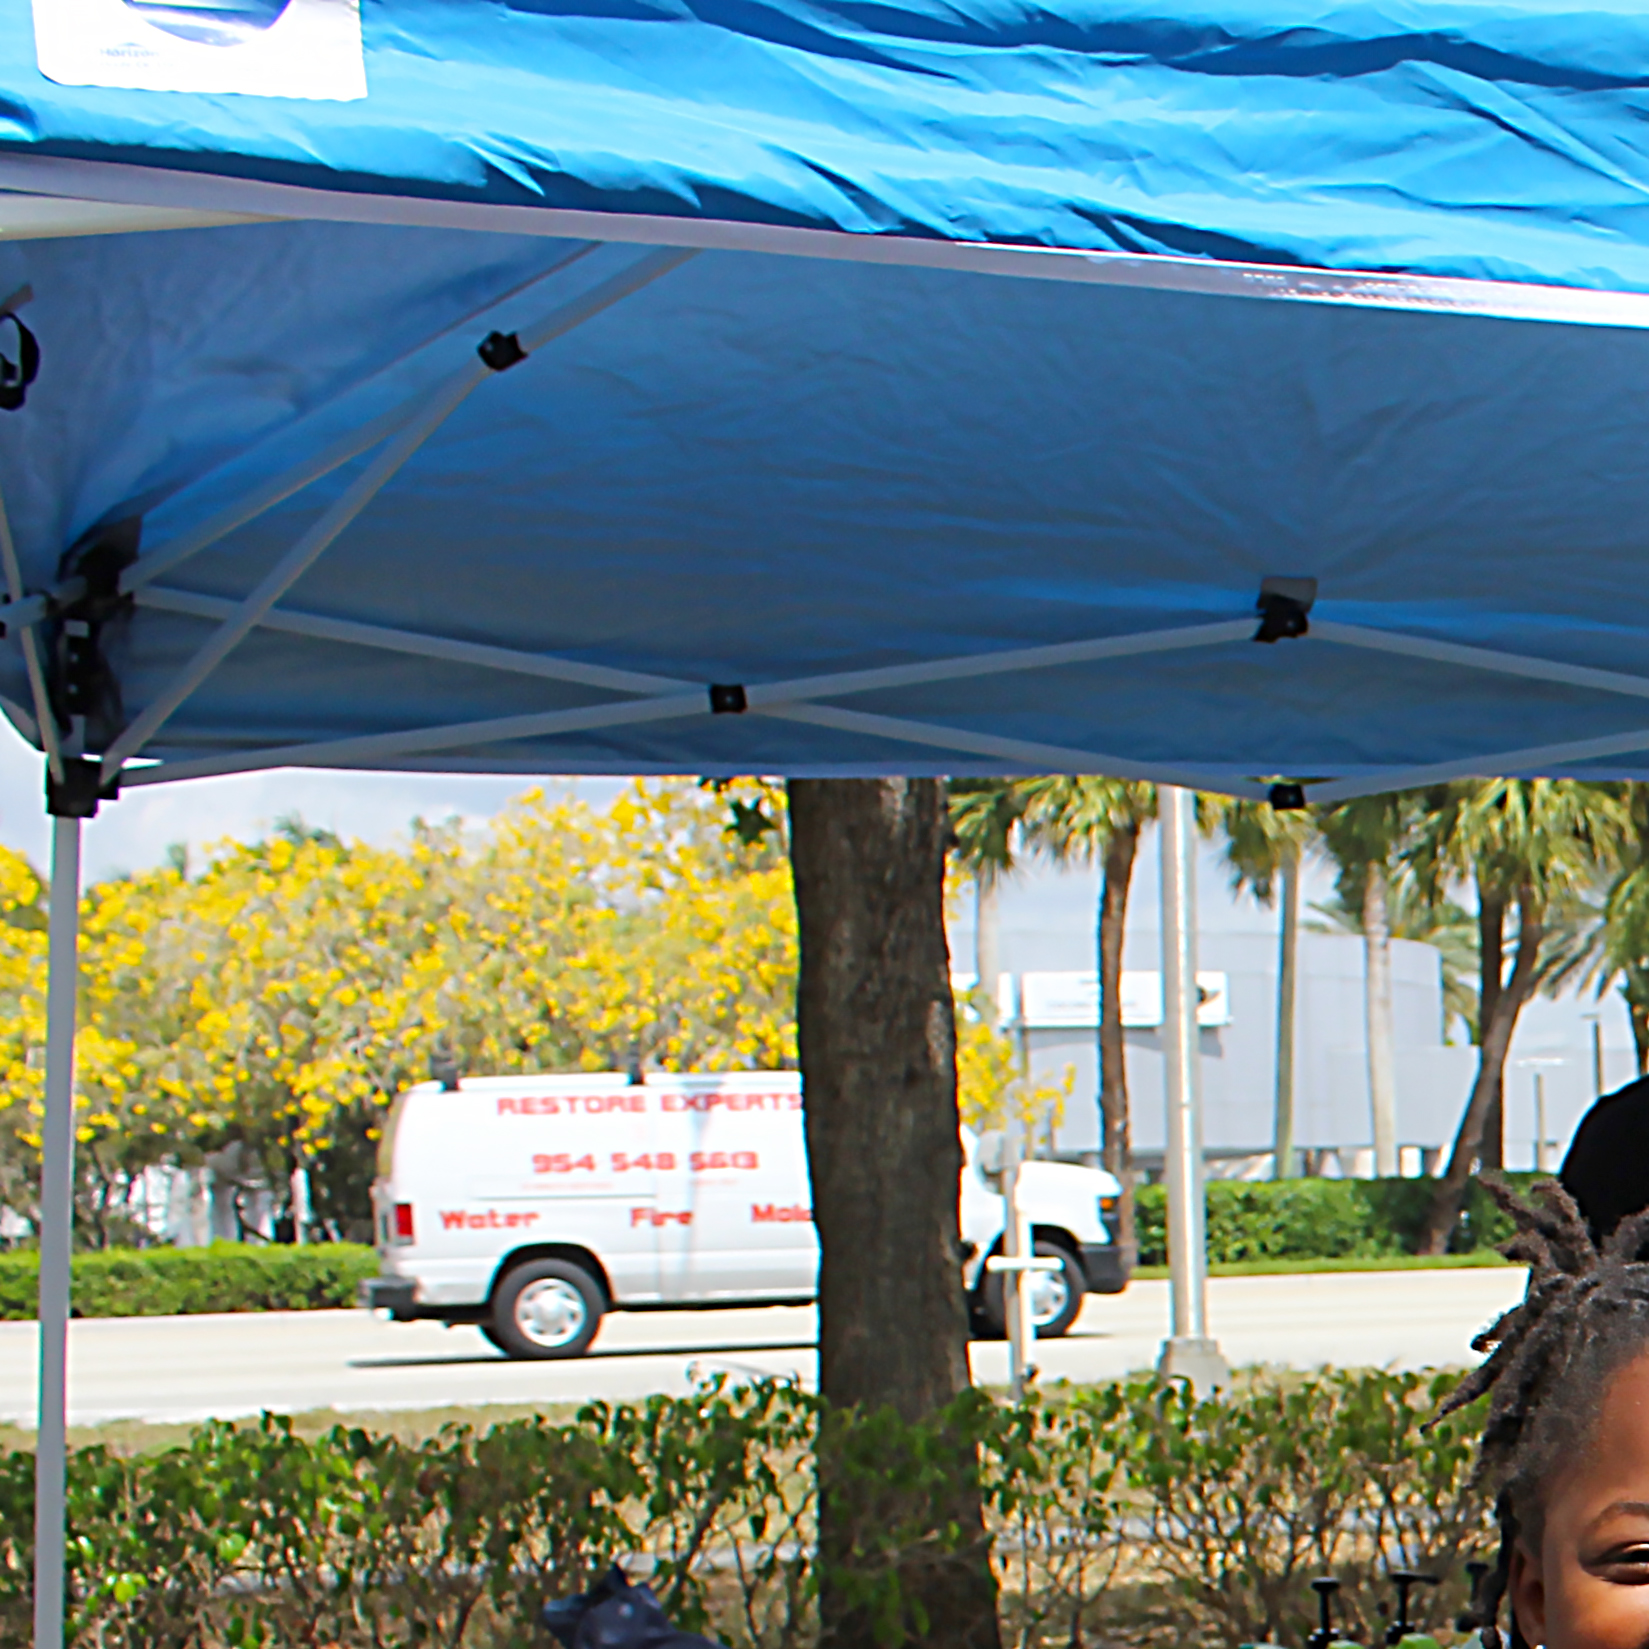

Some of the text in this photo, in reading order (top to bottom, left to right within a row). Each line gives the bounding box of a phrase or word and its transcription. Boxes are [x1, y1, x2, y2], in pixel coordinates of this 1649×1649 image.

[497, 1091, 803, 1116] RESTORE EXPERTS
[531, 1152, 596, 1174] 954
[439, 1208, 539, 1229] Water
[630, 1206, 693, 1228] Fire
